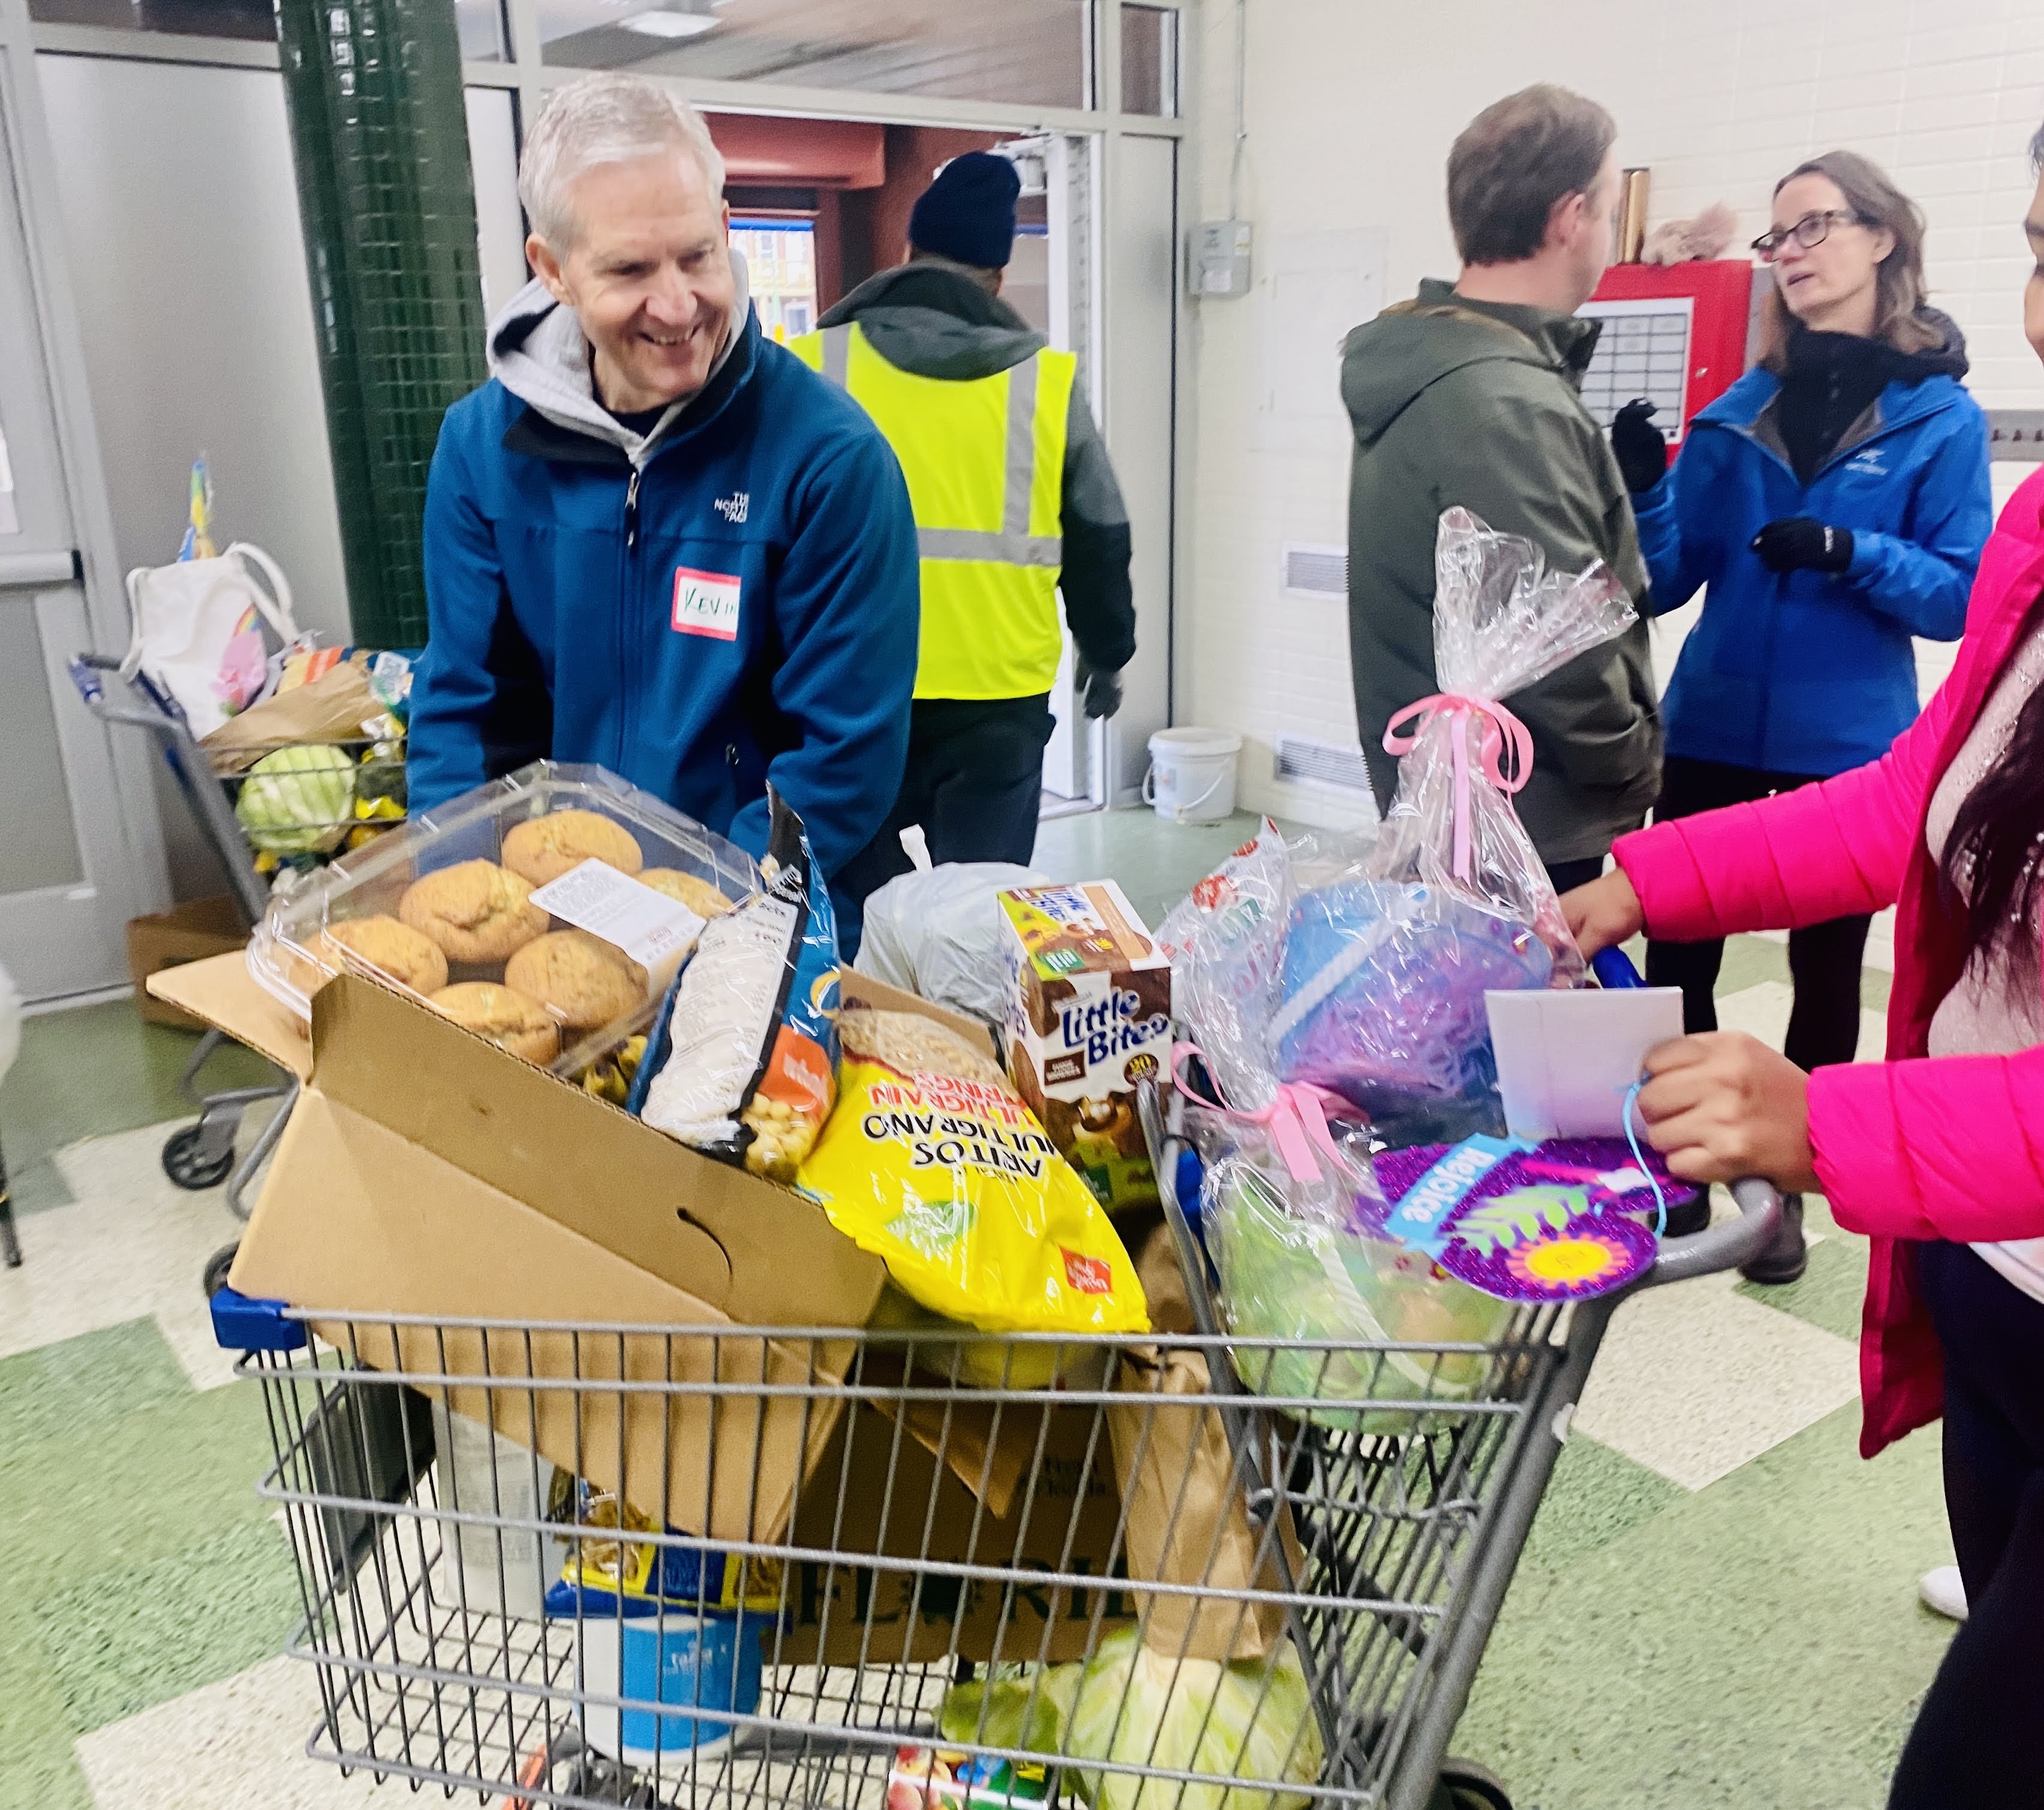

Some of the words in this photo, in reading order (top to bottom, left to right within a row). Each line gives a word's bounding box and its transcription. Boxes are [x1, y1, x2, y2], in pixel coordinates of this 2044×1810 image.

[1062, 991, 1139, 1048] Little
[1088, 1017, 1169, 1065] Bites
[872, 1086, 1035, 1127] ULTIGRAIN
[914, 1142, 1041, 1177] ARITOS
[1401, 1146, 1497, 1224] Rejoice
